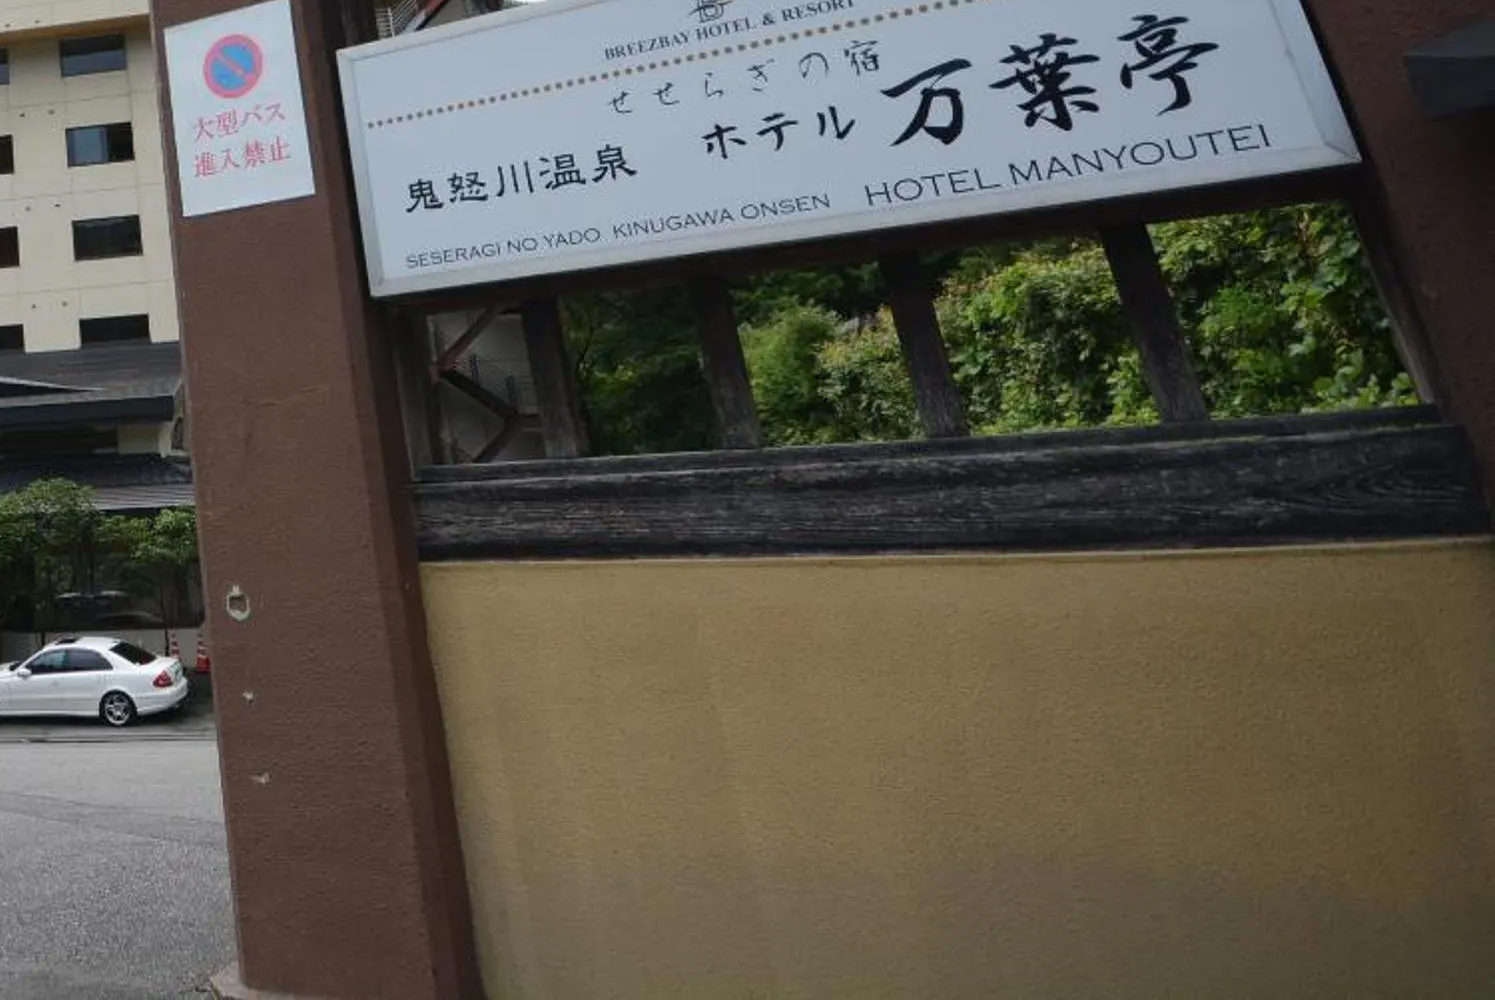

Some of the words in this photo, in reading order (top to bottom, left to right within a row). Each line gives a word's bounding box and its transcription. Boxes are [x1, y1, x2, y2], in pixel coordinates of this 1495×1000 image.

[603, 30, 691, 61] BREEZBAY
[695, 18, 758, 42] HOTEL
[761, 11, 777, 27] &
[608, 39, 881, 115] せせらぎの宿
[701, 104, 856, 160] ホテル
[879, 13, 1219, 147] 万葉亭
[193, 101, 287, 143] 大型バス
[193, 135, 292, 179] 進入禁止
[405, 144, 639, 213] 鬼怒川温泉
[864, 167, 1001, 207] HOTEL
[1009, 124, 1272, 186] MANYOUTEI
[406, 243, 503, 269] SESERAGI
[507, 236, 539, 255] NO
[542, 227, 602, 248] YADO
[612, 208, 735, 240] KINUGAWA
[739, 193, 831, 222] ONSEN
